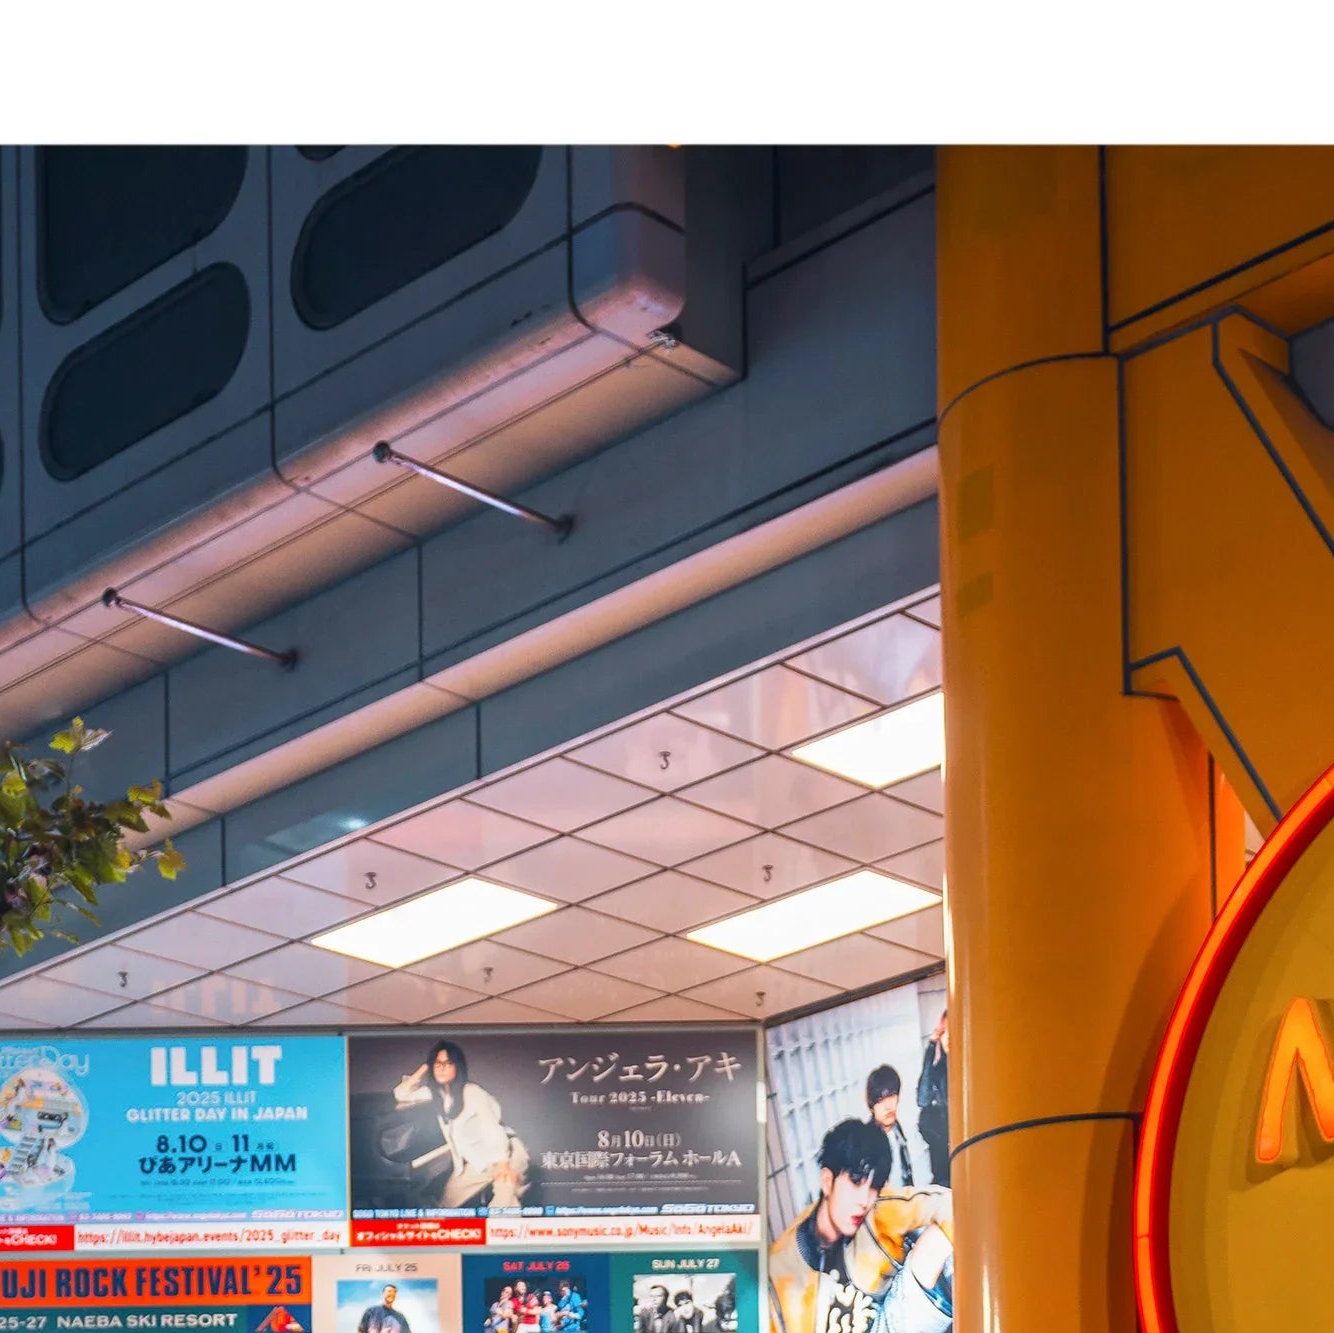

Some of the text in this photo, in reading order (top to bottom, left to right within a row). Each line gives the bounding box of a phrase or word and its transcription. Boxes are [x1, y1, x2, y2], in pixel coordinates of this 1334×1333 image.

[39, 1046, 90, 1077] Day
[151, 1046, 282, 1086] ILLIT
[538, 1052, 742, 1084] アンジェラ・アキ
[177, 1091, 257, 1106] 2025 ILLIT
[571, 1091, 604, 1104] Tour
[609, 1091, 646, 1103] 2025
[126, 1106, 307, 1122] GLITTER DAY IN JAPAN
[157, 1134, 207, 1153] 8.10
[232, 1134, 249, 1151] 11
[375, 1264, 401, 1273] JULY
[503, 1261, 522, 1271] SAT
[524, 1261, 553, 1271] JULY
[651, 1259, 720, 1270] SUN JULY 27
[55, 1267, 127, 1298] ROCK
[56, 1315, 121, 1329] NAEBA
[126, 1314, 157, 1328] SKI
[160, 1312, 238, 1328] RESORT
